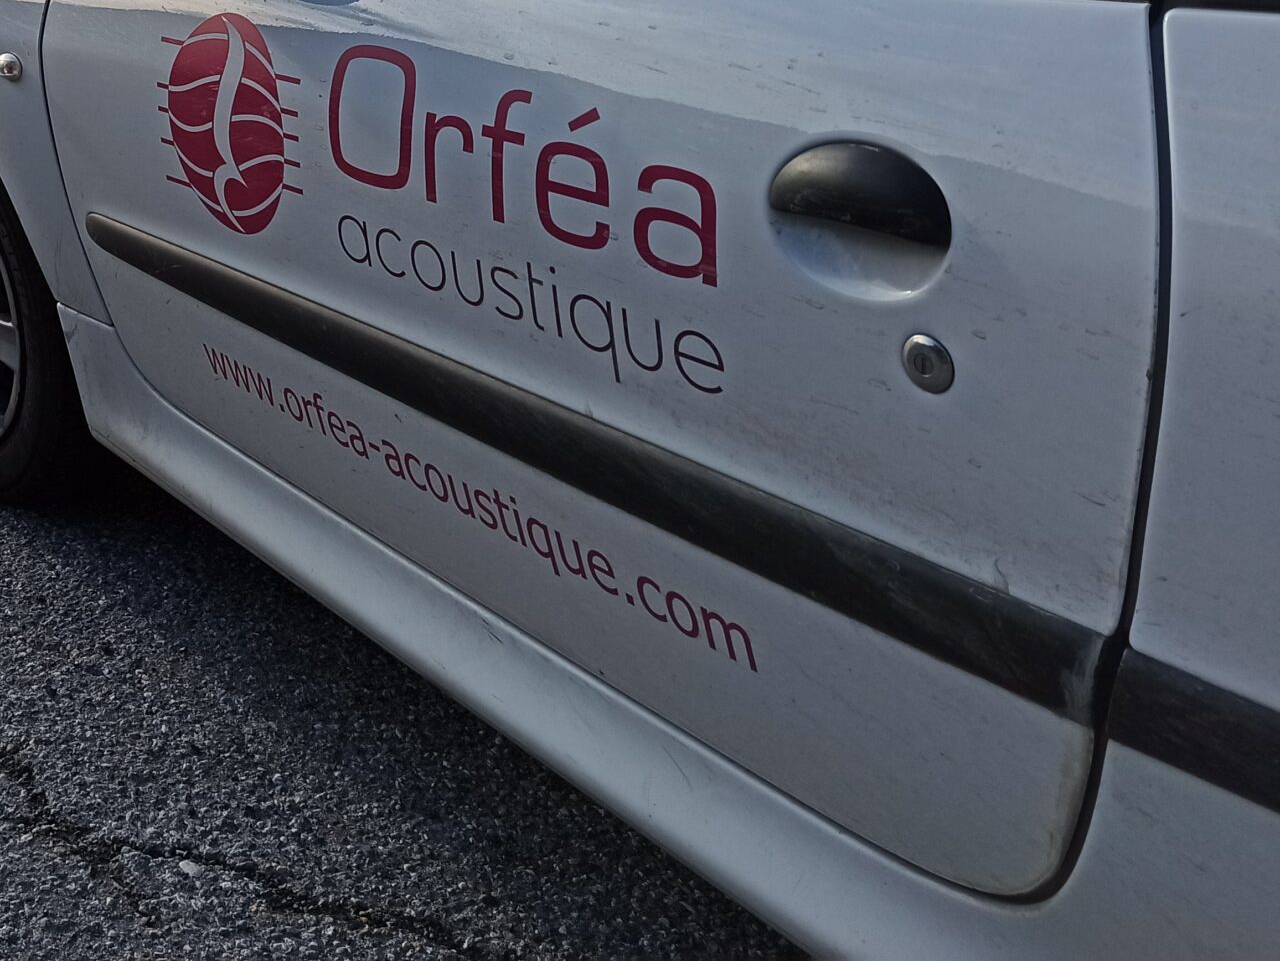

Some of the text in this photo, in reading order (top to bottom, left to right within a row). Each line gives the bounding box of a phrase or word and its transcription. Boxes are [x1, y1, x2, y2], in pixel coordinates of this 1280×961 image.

[328, 44, 718, 287] Orféa
[337, 214, 725, 394] acoustique
[202, 343, 758, 672] www.orfea-acoustique.com
